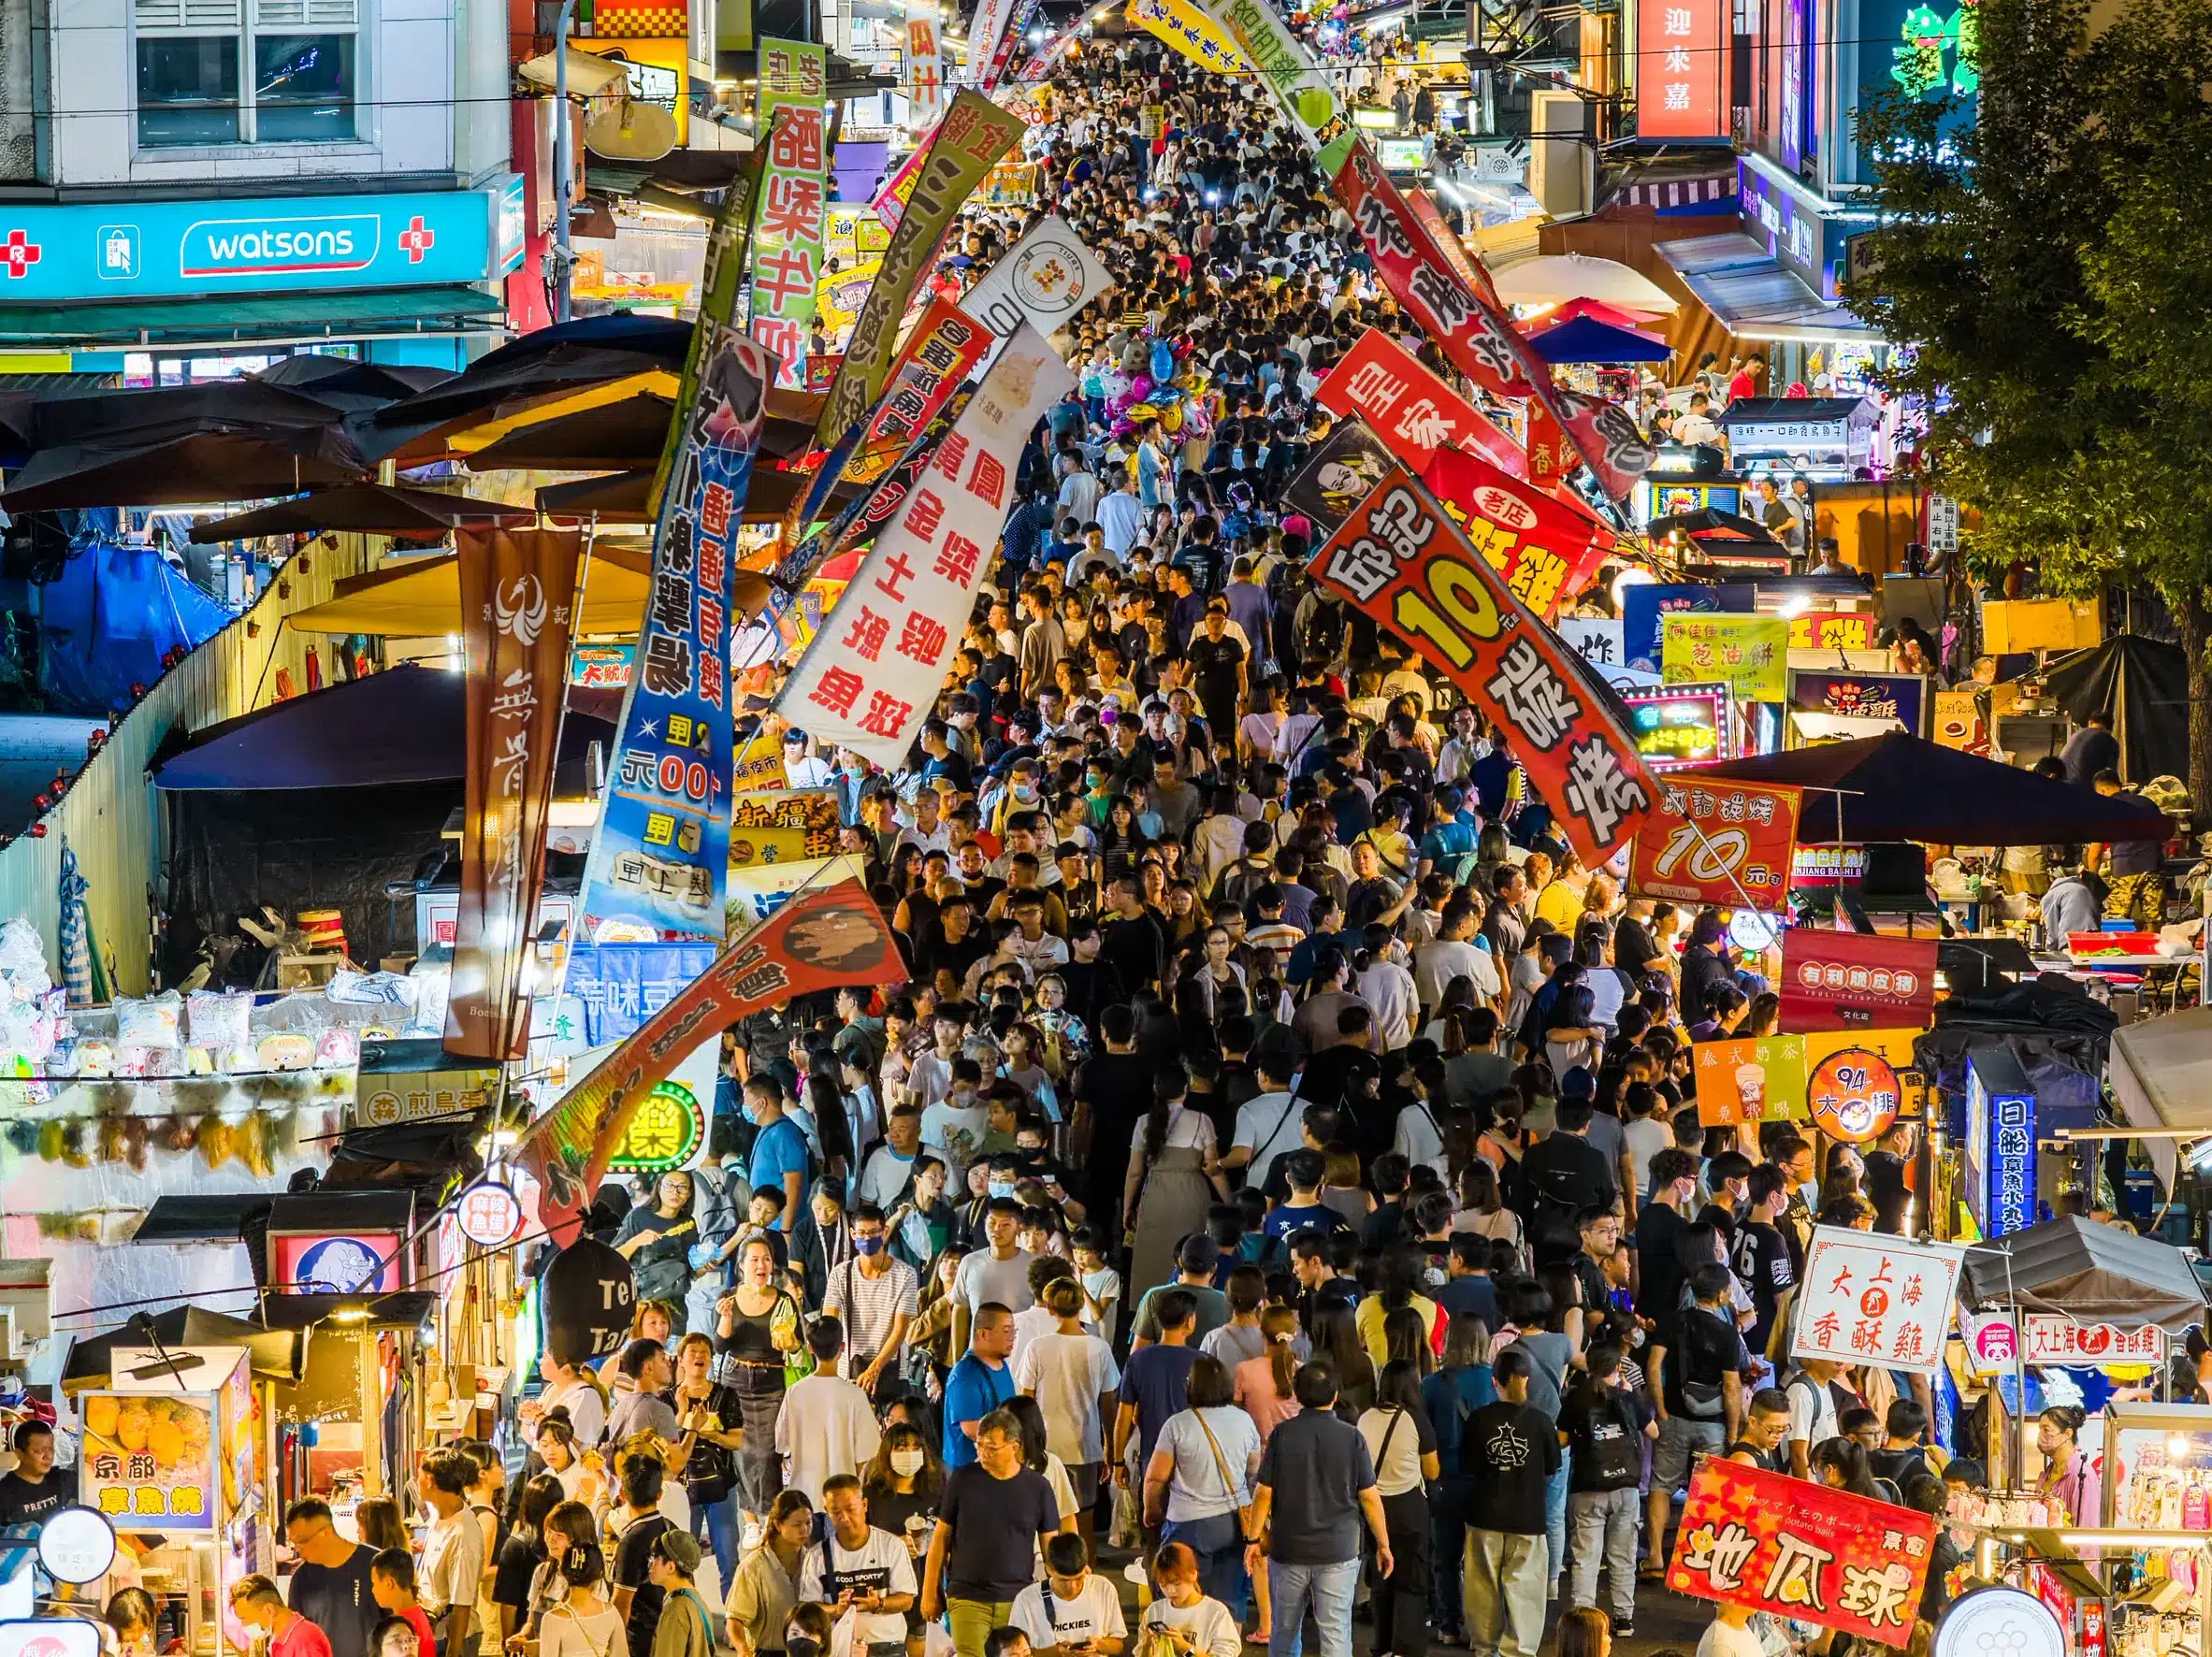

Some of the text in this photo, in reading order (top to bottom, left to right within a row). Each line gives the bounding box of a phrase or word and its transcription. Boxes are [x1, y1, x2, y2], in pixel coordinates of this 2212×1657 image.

[1663, 7, 1692, 111] 迎來嘉
[208, 227, 354, 261] watsons
[1482, 488, 1530, 526] 老店
[1931, 498, 1942, 549] 禁止右轉
[1324, 488, 1437, 602] 邱記
[732, 755, 779, 784] 福夜市
[736, 800, 808, 828] 新疆
[1793, 867, 1826, 875] INJIANG
[1843, 1011, 1870, 1020] 文化店
[1699, 1042, 1799, 1069] 泰式奶茶
[1836, 1067, 1872, 1093] 94
[372, 1097, 397, 1120] 森
[1828, 1256, 1923, 1307] 大上海
[1813, 1310, 1923, 1362] 香酥雞
[2035, 1324, 2075, 1353] 大上海
[93, 1455, 156, 1479] 京都
[23, 1494, 59, 1514] PRETTY
[98, 1486, 204, 1516] 章魚燒
[1744, 1494, 1864, 1535] サツマイモのボール
[1785, 1517, 1814, 1533] potato
[1683, 1520, 1914, 1628] 地瓜球
